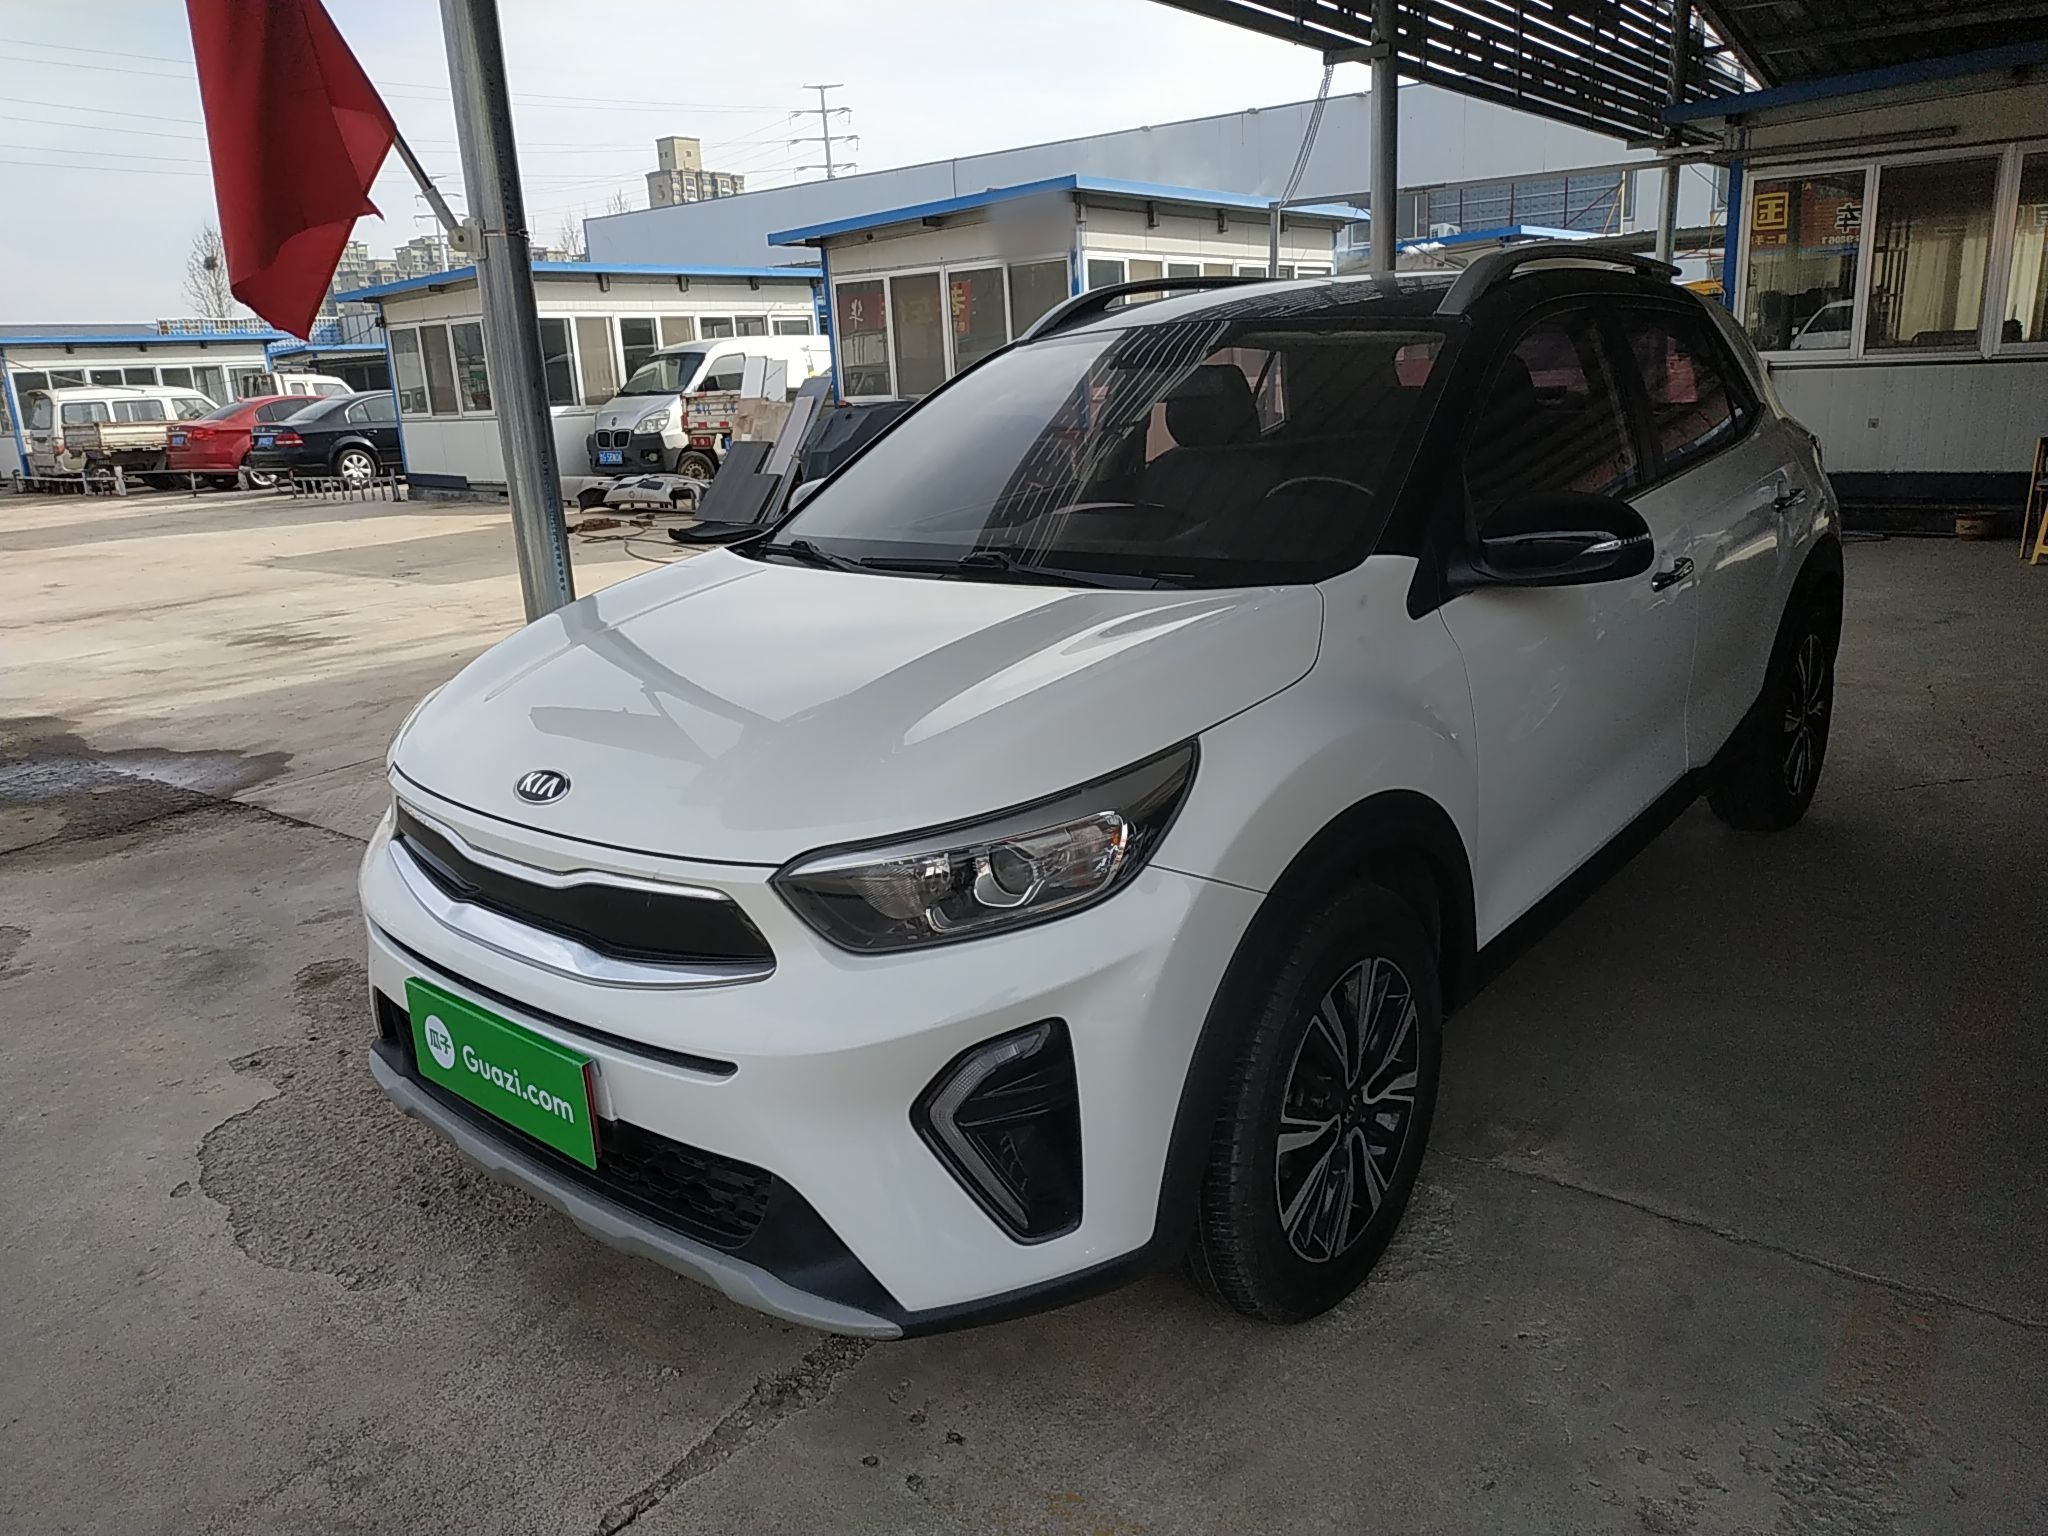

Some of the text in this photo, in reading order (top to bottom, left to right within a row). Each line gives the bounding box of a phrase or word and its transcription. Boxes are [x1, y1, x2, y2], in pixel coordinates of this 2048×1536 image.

[519, 772, 560, 798] KIA
[428, 1027, 576, 1124] 瓜子 Guazi.com
